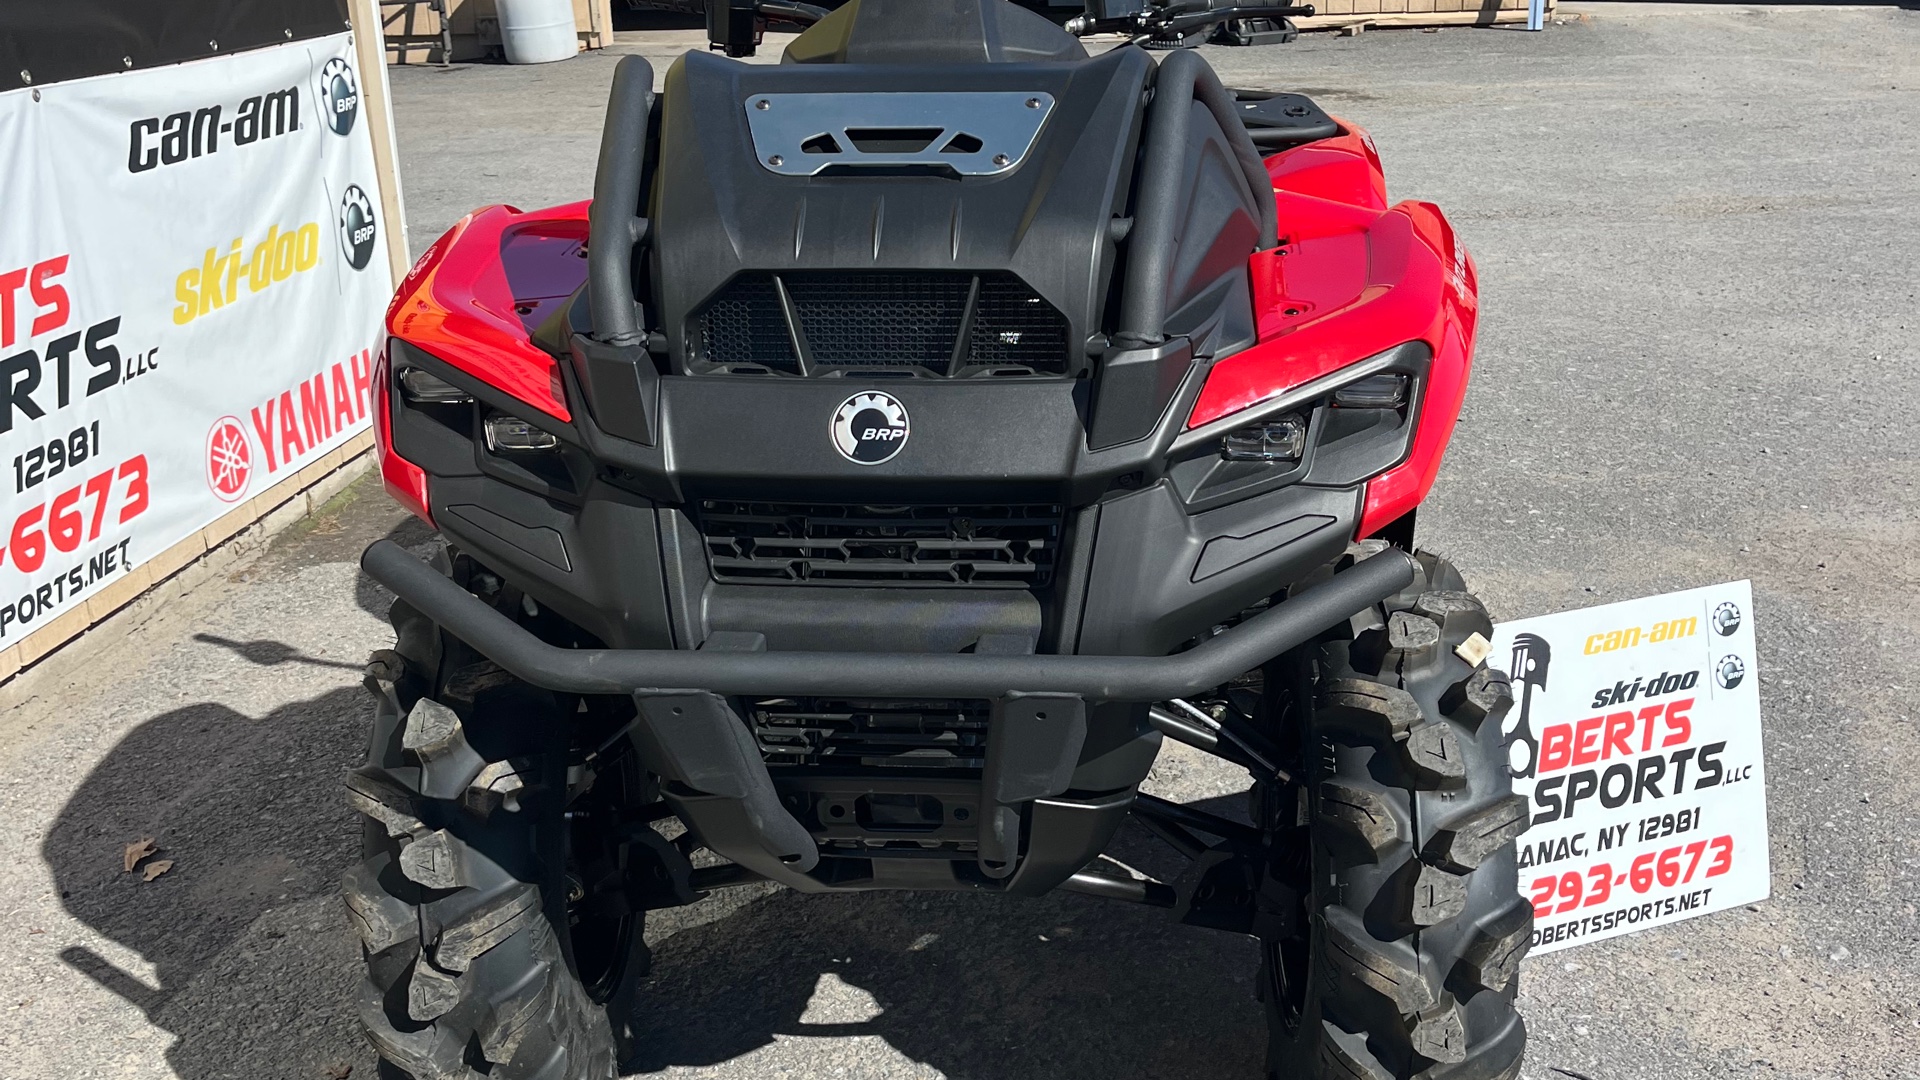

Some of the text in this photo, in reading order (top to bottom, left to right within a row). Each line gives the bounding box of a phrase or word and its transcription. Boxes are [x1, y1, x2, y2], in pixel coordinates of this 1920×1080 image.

[336, 96, 356, 114] BRP
[128, 85, 300, 173] can-am
[353, 225, 374, 245] BRP
[173, 222, 320, 326] ski-doo
[861, 428, 904, 441] BRP
[13, 419, 99, 494] 12981
[1583, 616, 1697, 655] can-am
[1724, 618, 1740, 627] BRP
[1591, 670, 1700, 709] ski-doo
[1727, 671, 1744, 680] BRP
[1537, 697, 1695, 773] BERTS
[1530, 740, 1727, 826] SPORTS
[1597, 822, 1630, 852] NY
[1638, 806, 1701, 842] 12981
[1530, 834, 1734, 918] 293-6673
